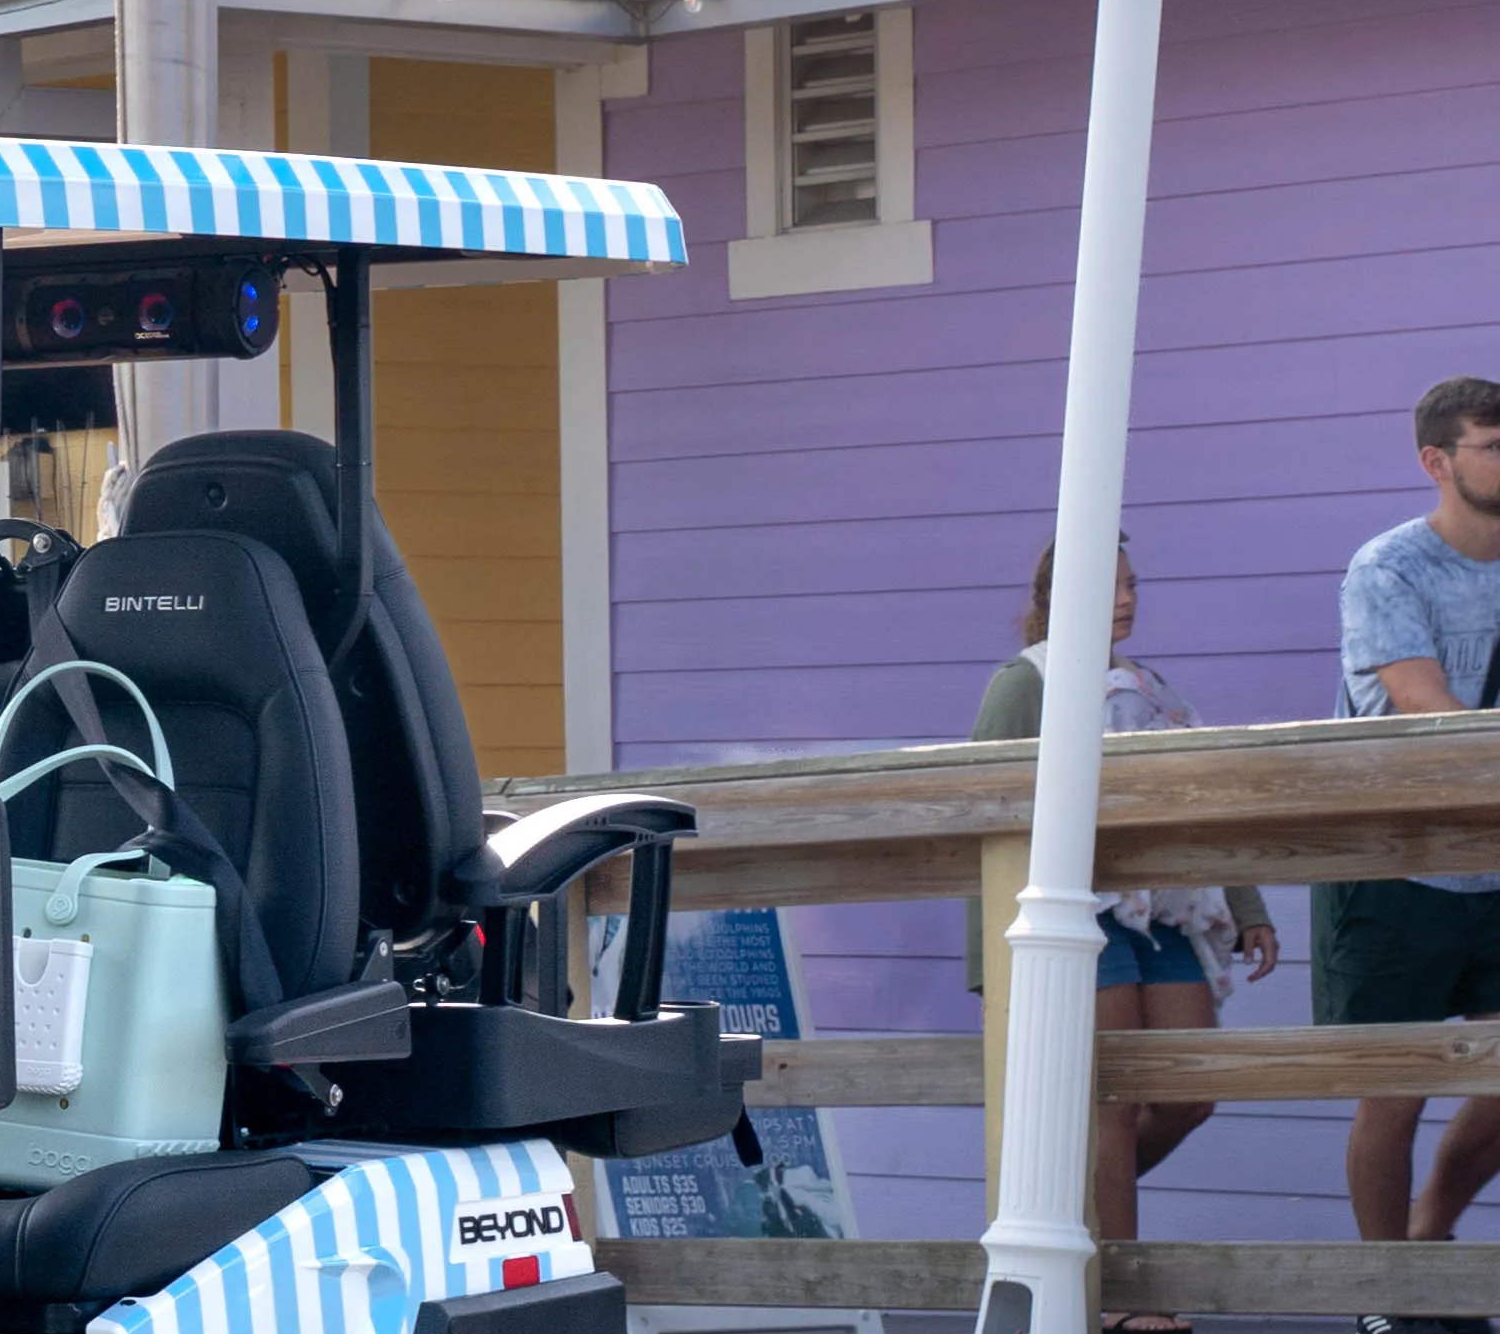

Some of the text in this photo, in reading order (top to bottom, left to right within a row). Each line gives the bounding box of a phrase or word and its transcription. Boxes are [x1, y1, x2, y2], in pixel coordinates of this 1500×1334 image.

[105, 595, 204, 612] BINTELLI
[752, 961, 777, 973] AND
[719, 1003, 781, 1033] TOURS
[694, 1152, 742, 1169] CRUIS
[623, 1174, 698, 1195] ADULTS $35
[626, 1195, 706, 1216] SENIORS $30
[458, 1206, 564, 1245] BEYOND
[629, 1216, 687, 1237] KIDS $25
